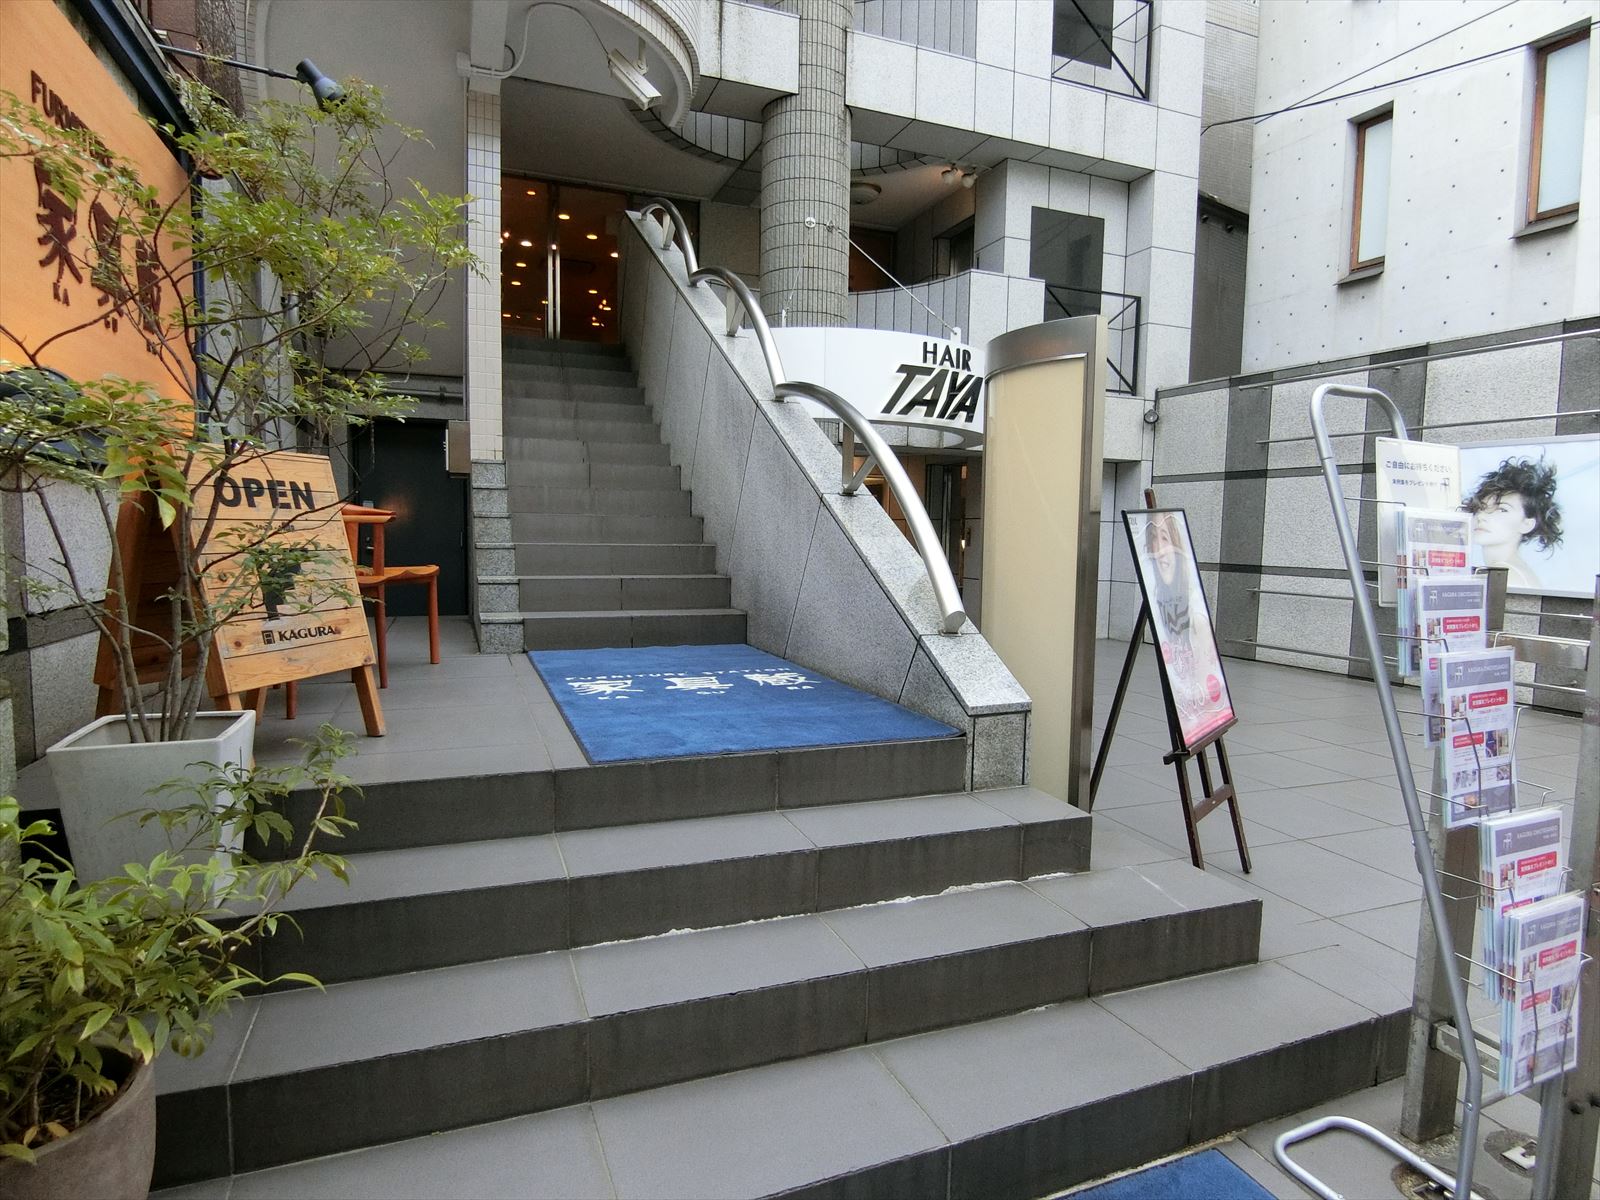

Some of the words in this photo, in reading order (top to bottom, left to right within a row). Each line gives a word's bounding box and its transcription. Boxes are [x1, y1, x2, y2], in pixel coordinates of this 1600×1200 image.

[922, 341, 972, 372] HAIR
[880, 363, 984, 424] TAYA
[213, 475, 317, 512] OPEN
[277, 625, 337, 642] KAGURA
